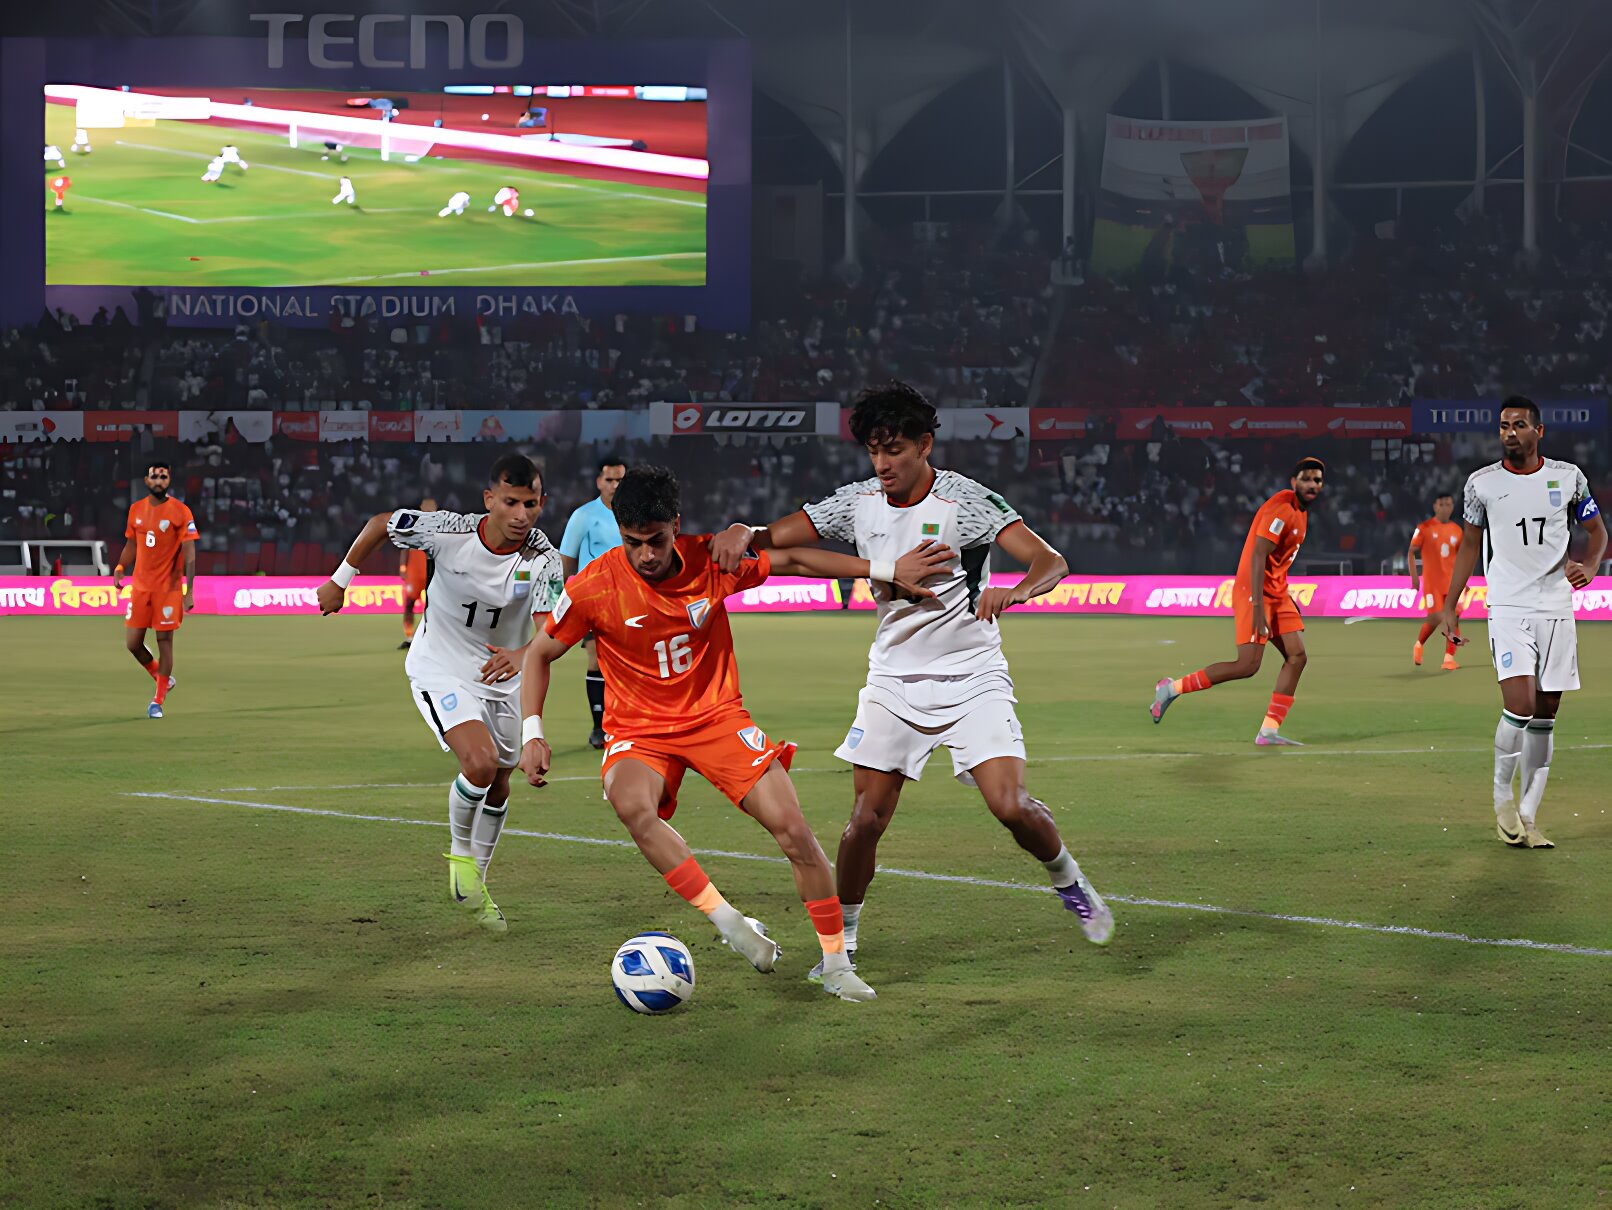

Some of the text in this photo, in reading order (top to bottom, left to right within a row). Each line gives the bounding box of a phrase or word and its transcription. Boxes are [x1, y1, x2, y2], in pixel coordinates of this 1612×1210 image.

[250, 13, 524, 69] TECNO
[171, 294, 579, 317] NATIONAL STADIUM DHAKA
[705, 410, 806, 427] LOTTO
[1539, 408, 1589, 422] CNO
[145, 530, 156, 548] 6
[1515, 517, 1546, 545] 17
[462, 601, 502, 629] 11
[653, 634, 692, 679] 16
